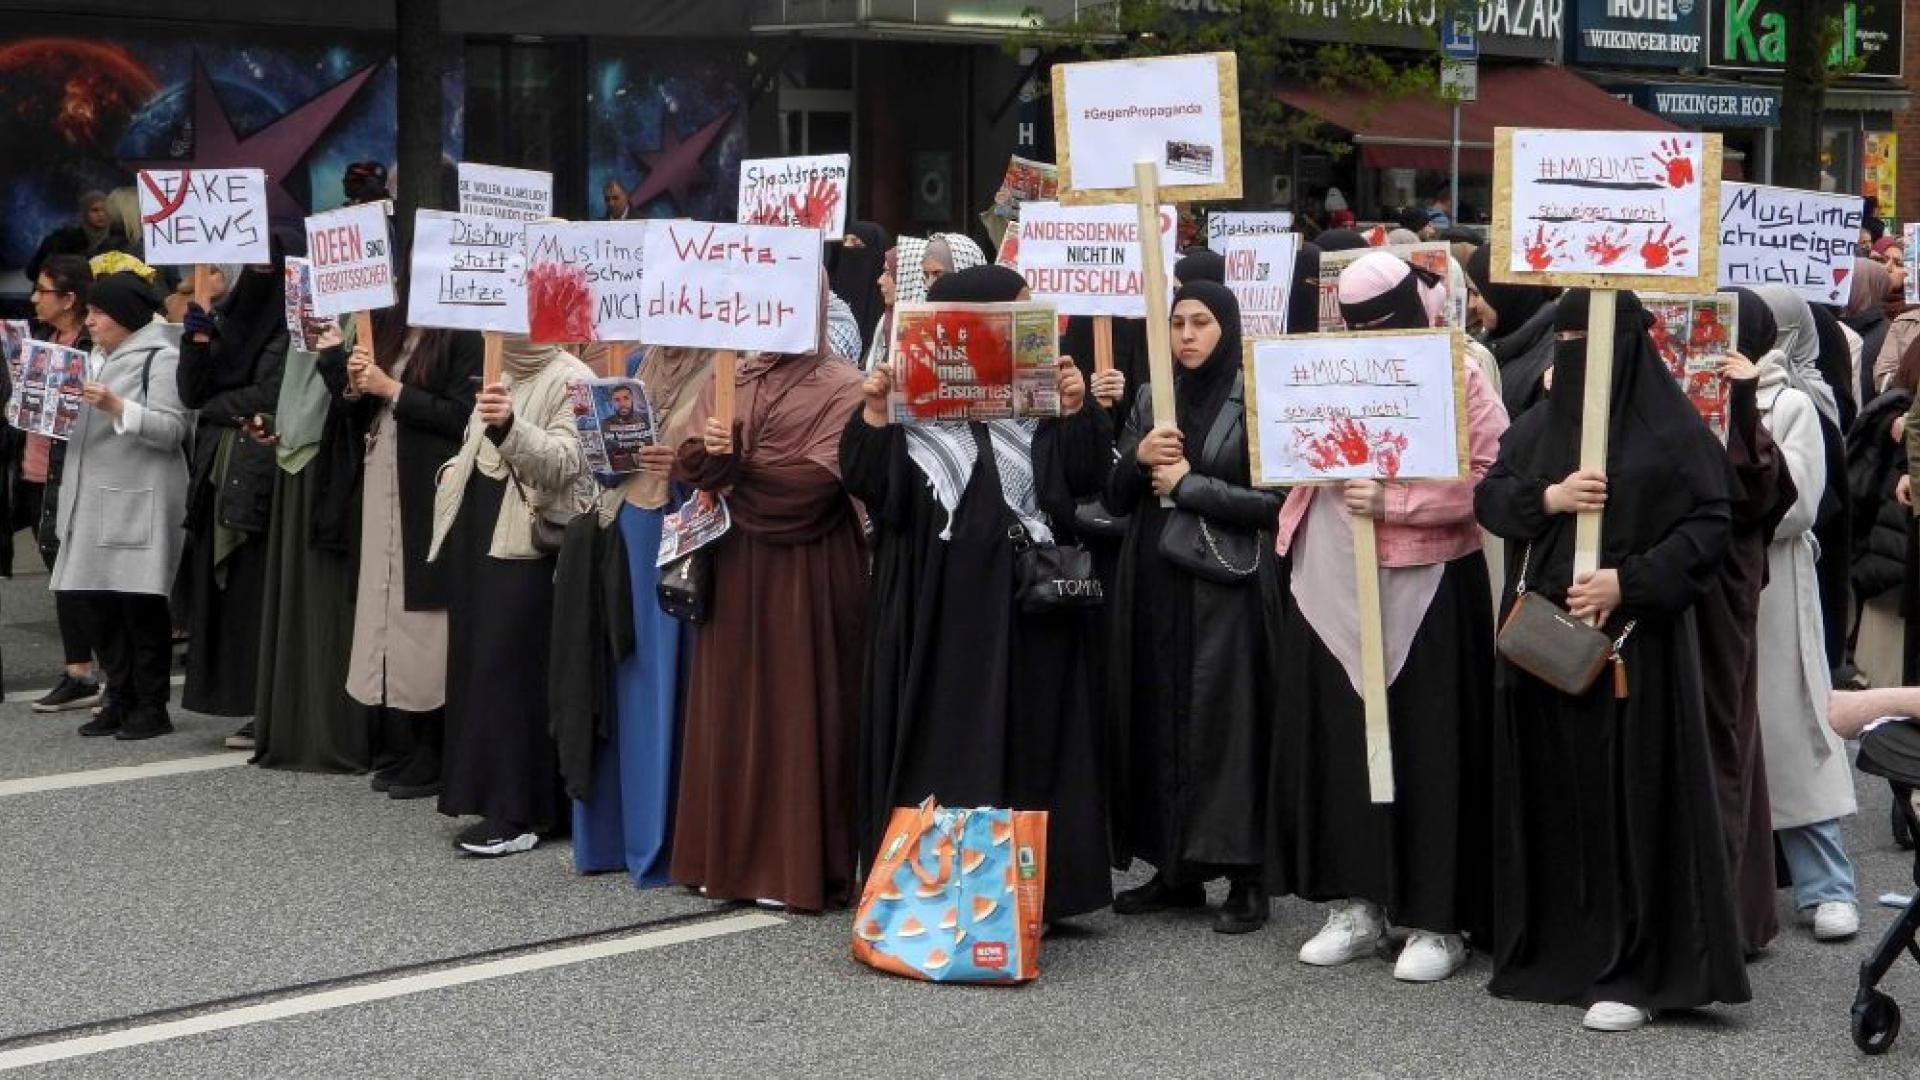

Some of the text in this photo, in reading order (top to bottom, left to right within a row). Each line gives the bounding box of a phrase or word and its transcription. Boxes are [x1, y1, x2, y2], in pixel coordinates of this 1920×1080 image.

[1587, 29, 1701, 53] WIKINGER HOF
[1084, 103, 1203, 121] #GegenPropaganda
[1655, 93, 1738, 114] WIKINGER
[1742, 97, 1773, 117] HOF
[1539, 157, 1650, 181] #MUSLIME
[160, 175, 248, 204] FAKE
[1538, 197, 1667, 222] schweigen nicht!
[151, 209, 259, 247] NEWS
[1022, 220, 1141, 242] ANDERSDENKE
[310, 223, 363, 268] IDEEN
[531, 234, 644, 264] Muslime
[1067, 245, 1125, 264] NICHT IN
[1721, 225, 1858, 265] chweigen
[439, 273, 504, 301] Hetze
[1024, 268, 1144, 295] DEUTSCHLA
[648, 280, 794, 327] diktatur
[1291, 358, 1411, 384] #MUSLIME
[1283, 397, 1409, 420] schweigen nicht!
